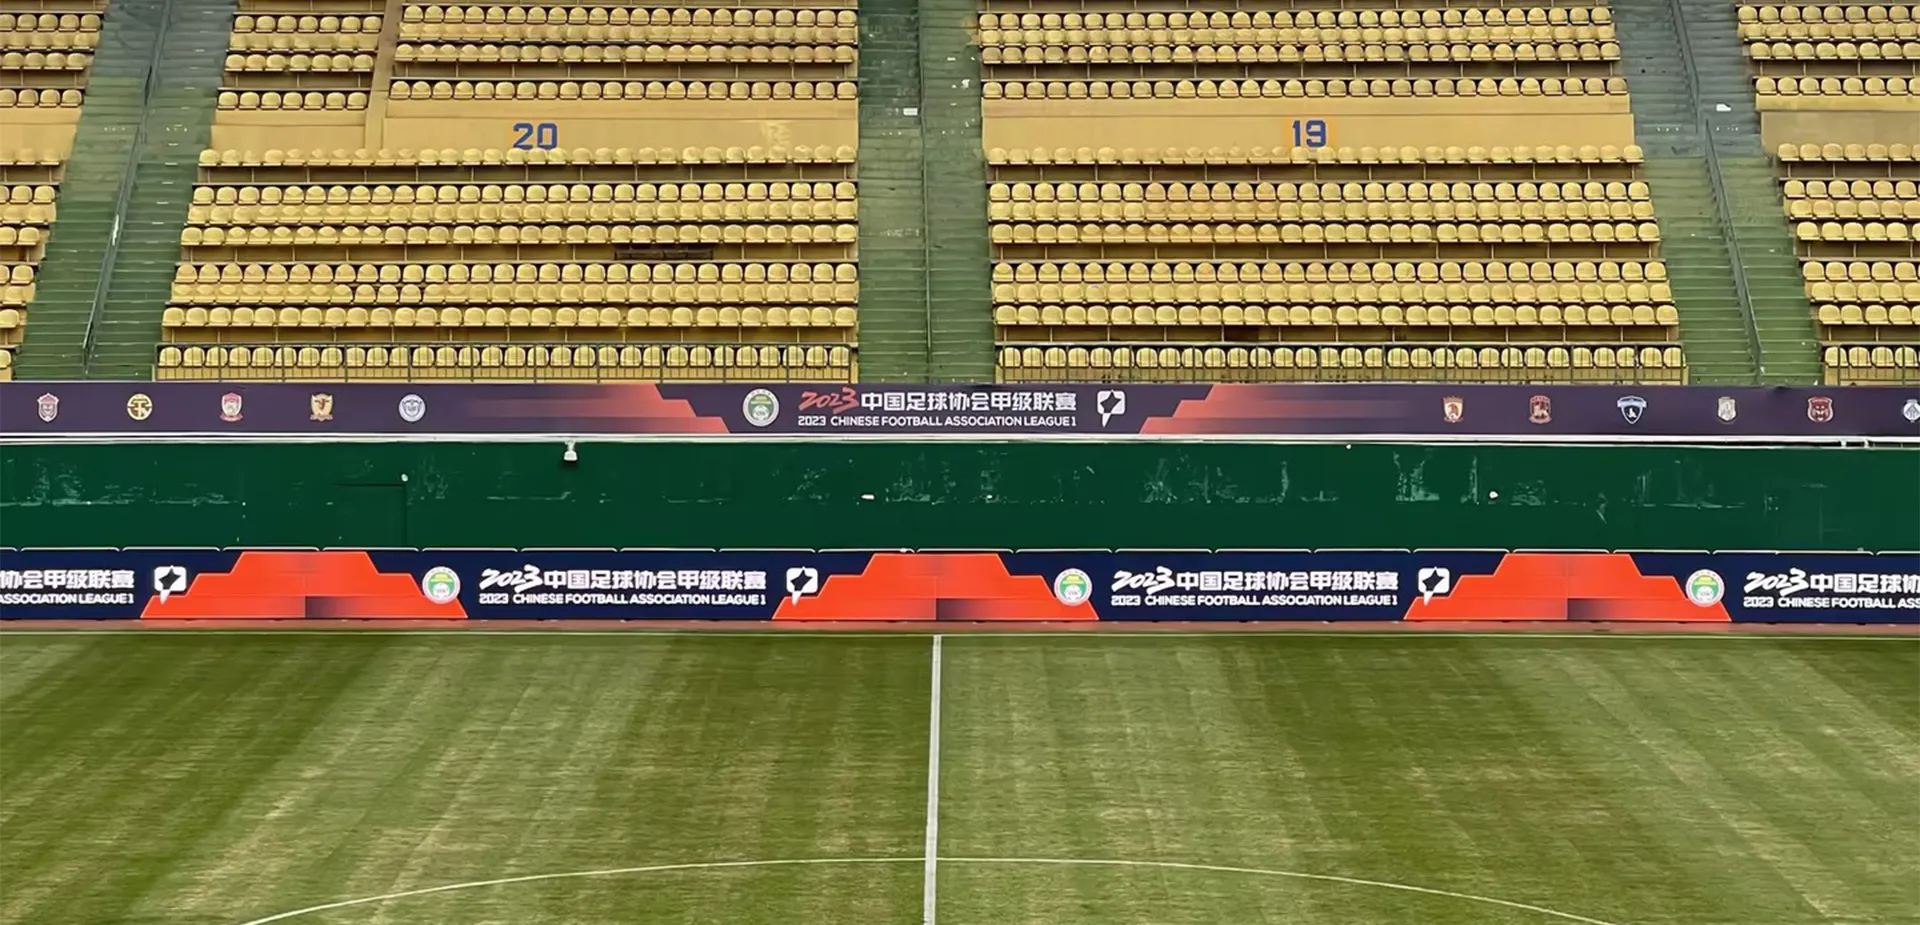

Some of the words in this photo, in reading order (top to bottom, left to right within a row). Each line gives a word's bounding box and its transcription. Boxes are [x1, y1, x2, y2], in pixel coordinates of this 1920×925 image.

[513, 122, 557, 151] 20
[1292, 120, 1326, 148] 19
[798, 415, 826, 426] 2023
[830, 415, 879, 426] CHINESE
[881, 415, 943, 426] FOOTBALL
[944, 415, 1022, 426] ASSOCIATION
[479, 593, 509, 605] 2023
[513, 593, 563, 605] CHINESE
[565, 593, 628, 605] FOOTBALL
[629, 593, 710, 605] ASSOCIATION
[1111, 594, 1141, 606] 2023
[1145, 594, 1196, 606] CHINESE
[1198, 594, 1261, 606] FOOTBALL
[1261, 594, 1343, 606] ASSOCIATION
[1743, 596, 1774, 608] 2023
[1777, 596, 1830, 608] CHINESE
[1831, 596, 1896, 608] FOOTBALL
